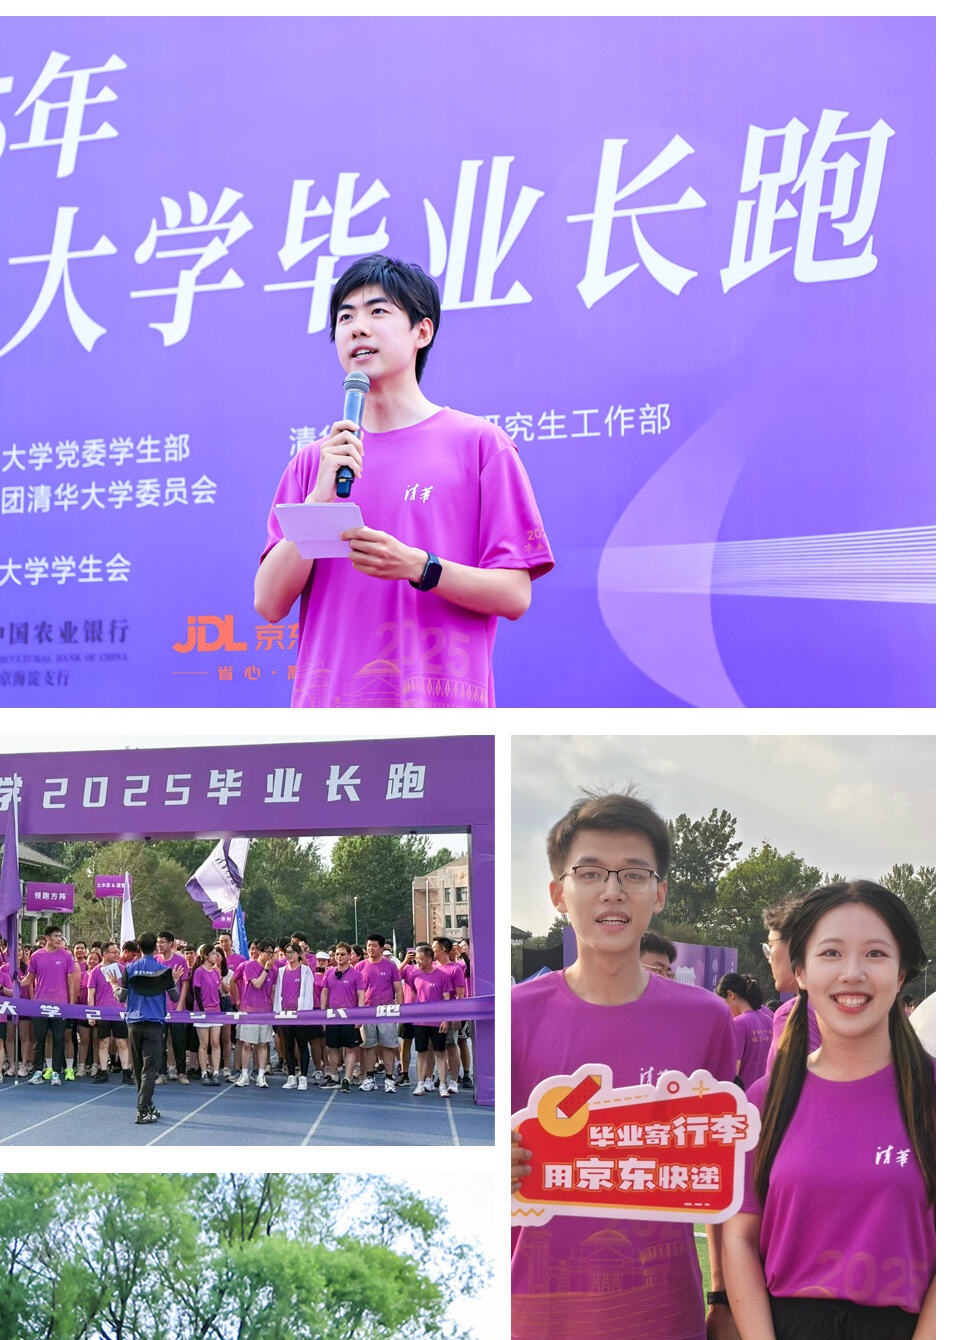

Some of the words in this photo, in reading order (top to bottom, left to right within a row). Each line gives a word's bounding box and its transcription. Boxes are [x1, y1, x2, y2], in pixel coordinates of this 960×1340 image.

[172, 614, 248, 653] JDL
[34, 891, 67, 900] 领跑方阵
[589, 1114, 748, 1148] 毕业寄行李
[544, 1157, 721, 1191] 用京东快递
